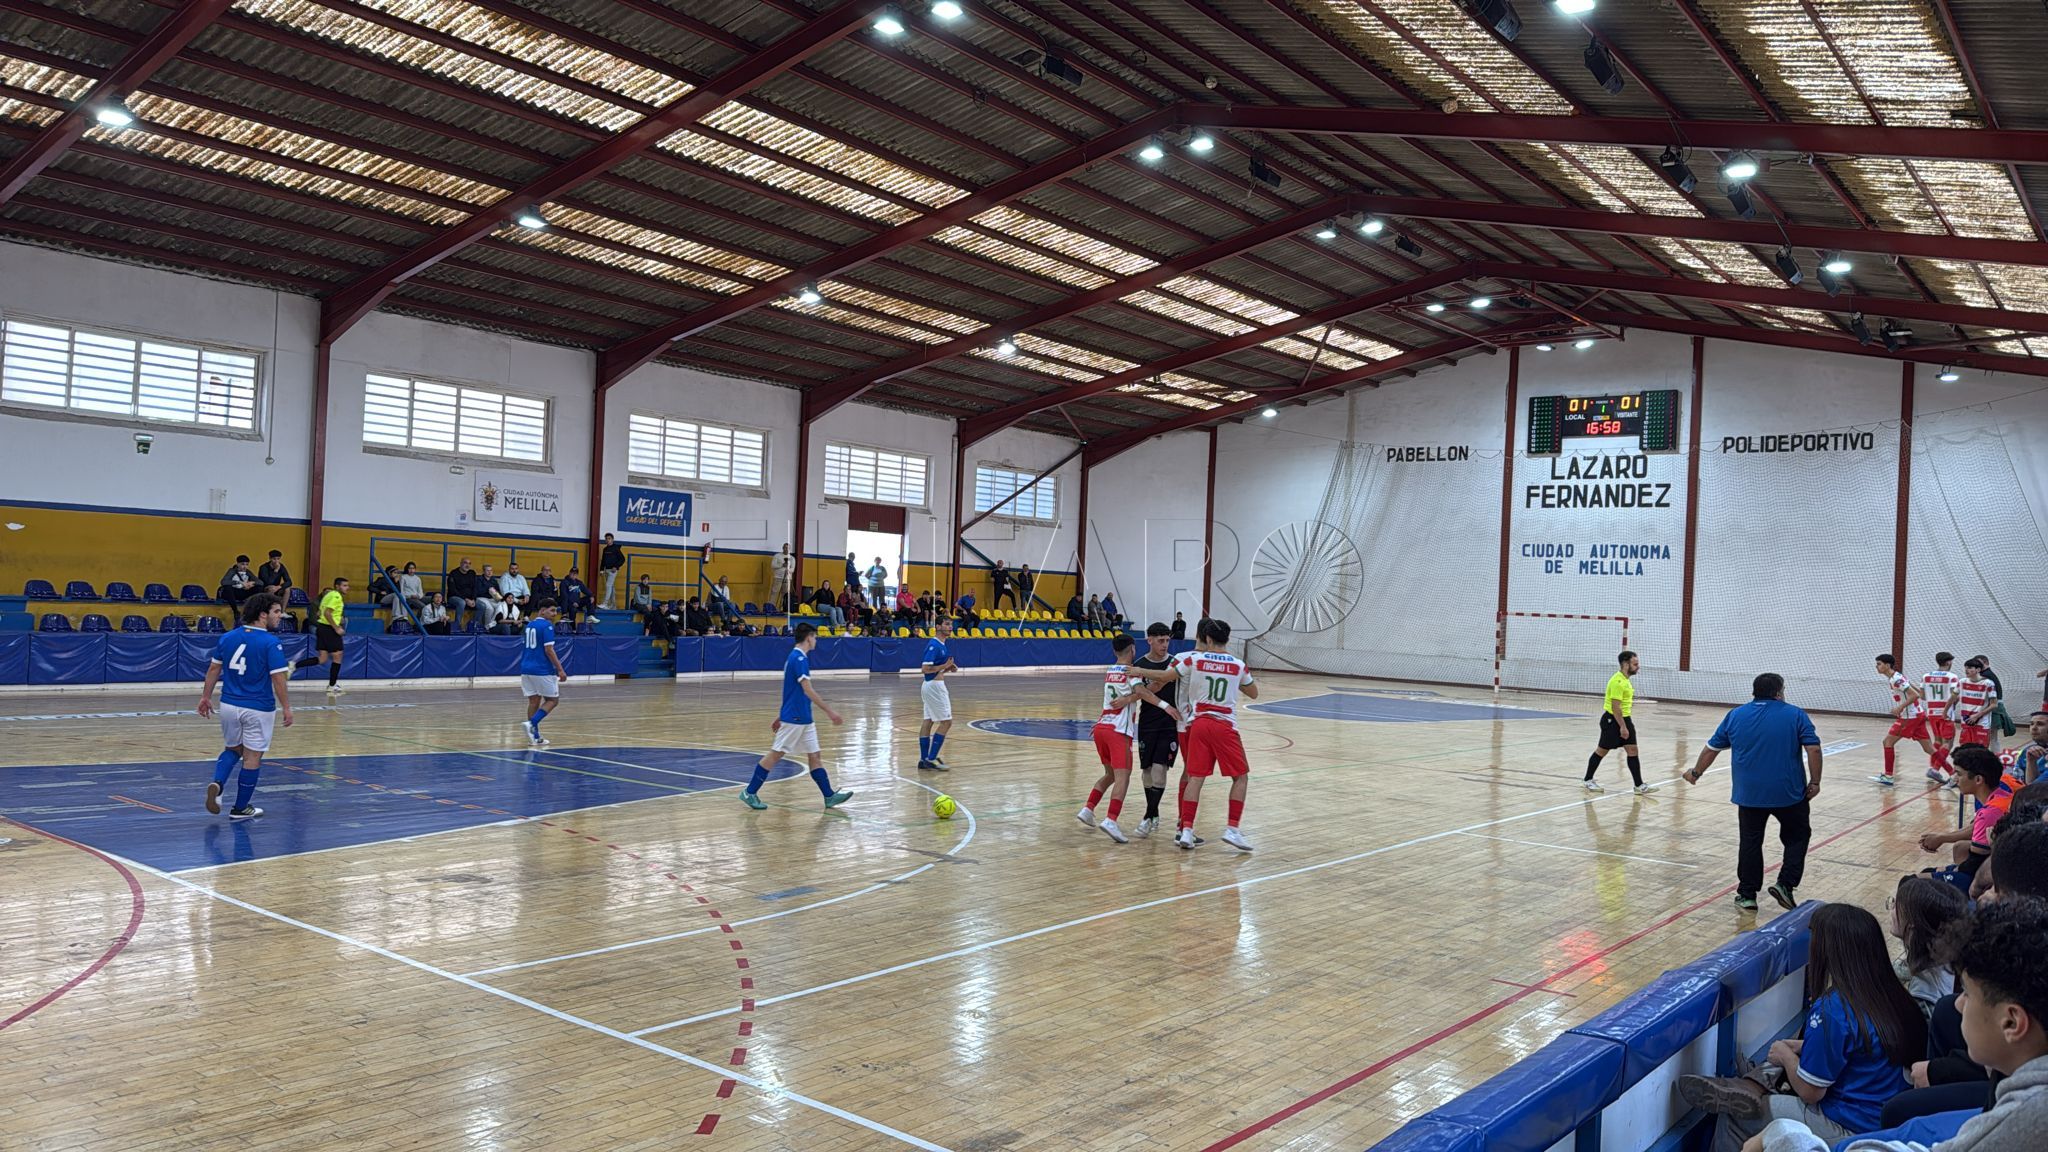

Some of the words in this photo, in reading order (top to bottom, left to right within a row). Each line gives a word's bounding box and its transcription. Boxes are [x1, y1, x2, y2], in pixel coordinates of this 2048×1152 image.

[1569, 399, 1588, 412] 01
[1621, 396, 1640, 410] 01
[1586, 421, 1621, 435] 16:58
[1723, 432, 1874, 453] POLIDEPORTIVO
[1386, 445, 1469, 462] PABELLON
[1551, 455, 1648, 480] LAZARO
[503, 488, 525, 496] CIUDAD
[1526, 483, 1672, 508] FERNANDEZ
[504, 496, 559, 513] MELILLA
[626, 497, 686, 519] MELILLA
[648, 517, 659, 525] DEL
[1522, 543, 1575, 558] CIUDAD
[1590, 544, 1671, 560] AUTONOMA
[1545, 560, 1564, 574] DE
[1579, 561, 1644, 576] MELILLA
[525, 627, 537, 650] 10
[229, 643, 247, 676] 4
[1205, 676, 1228, 702] 10
[1929, 684, 1943, 700] 14
